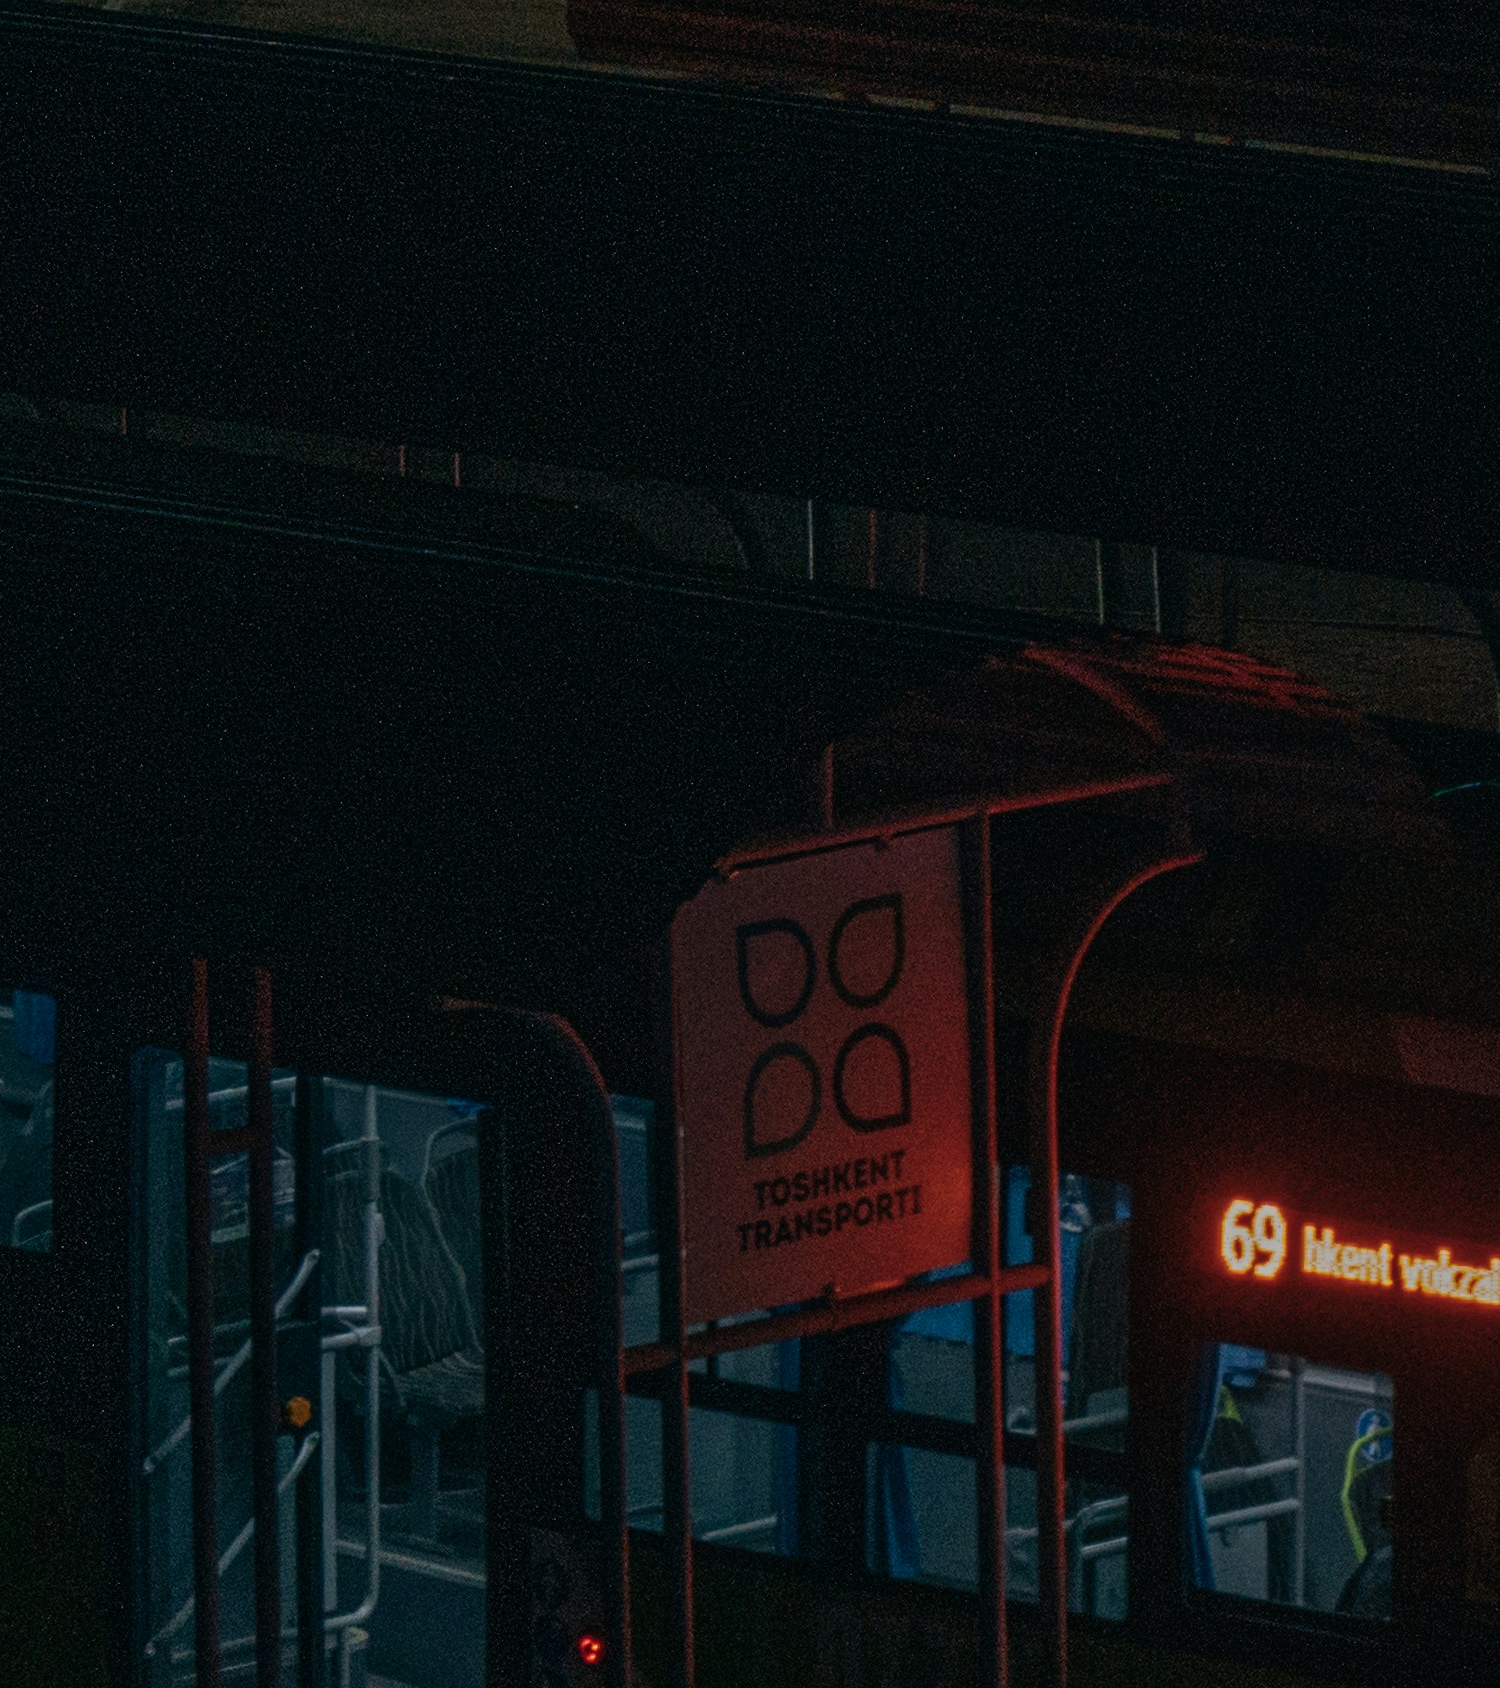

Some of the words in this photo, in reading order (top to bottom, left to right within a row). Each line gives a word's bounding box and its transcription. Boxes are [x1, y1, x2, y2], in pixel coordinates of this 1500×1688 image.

[753, 1149, 906, 1210] TOSHKENT
[736, 1184, 923, 1253] TRANSPORTI
[1220, 1198, 1287, 1279] 69
